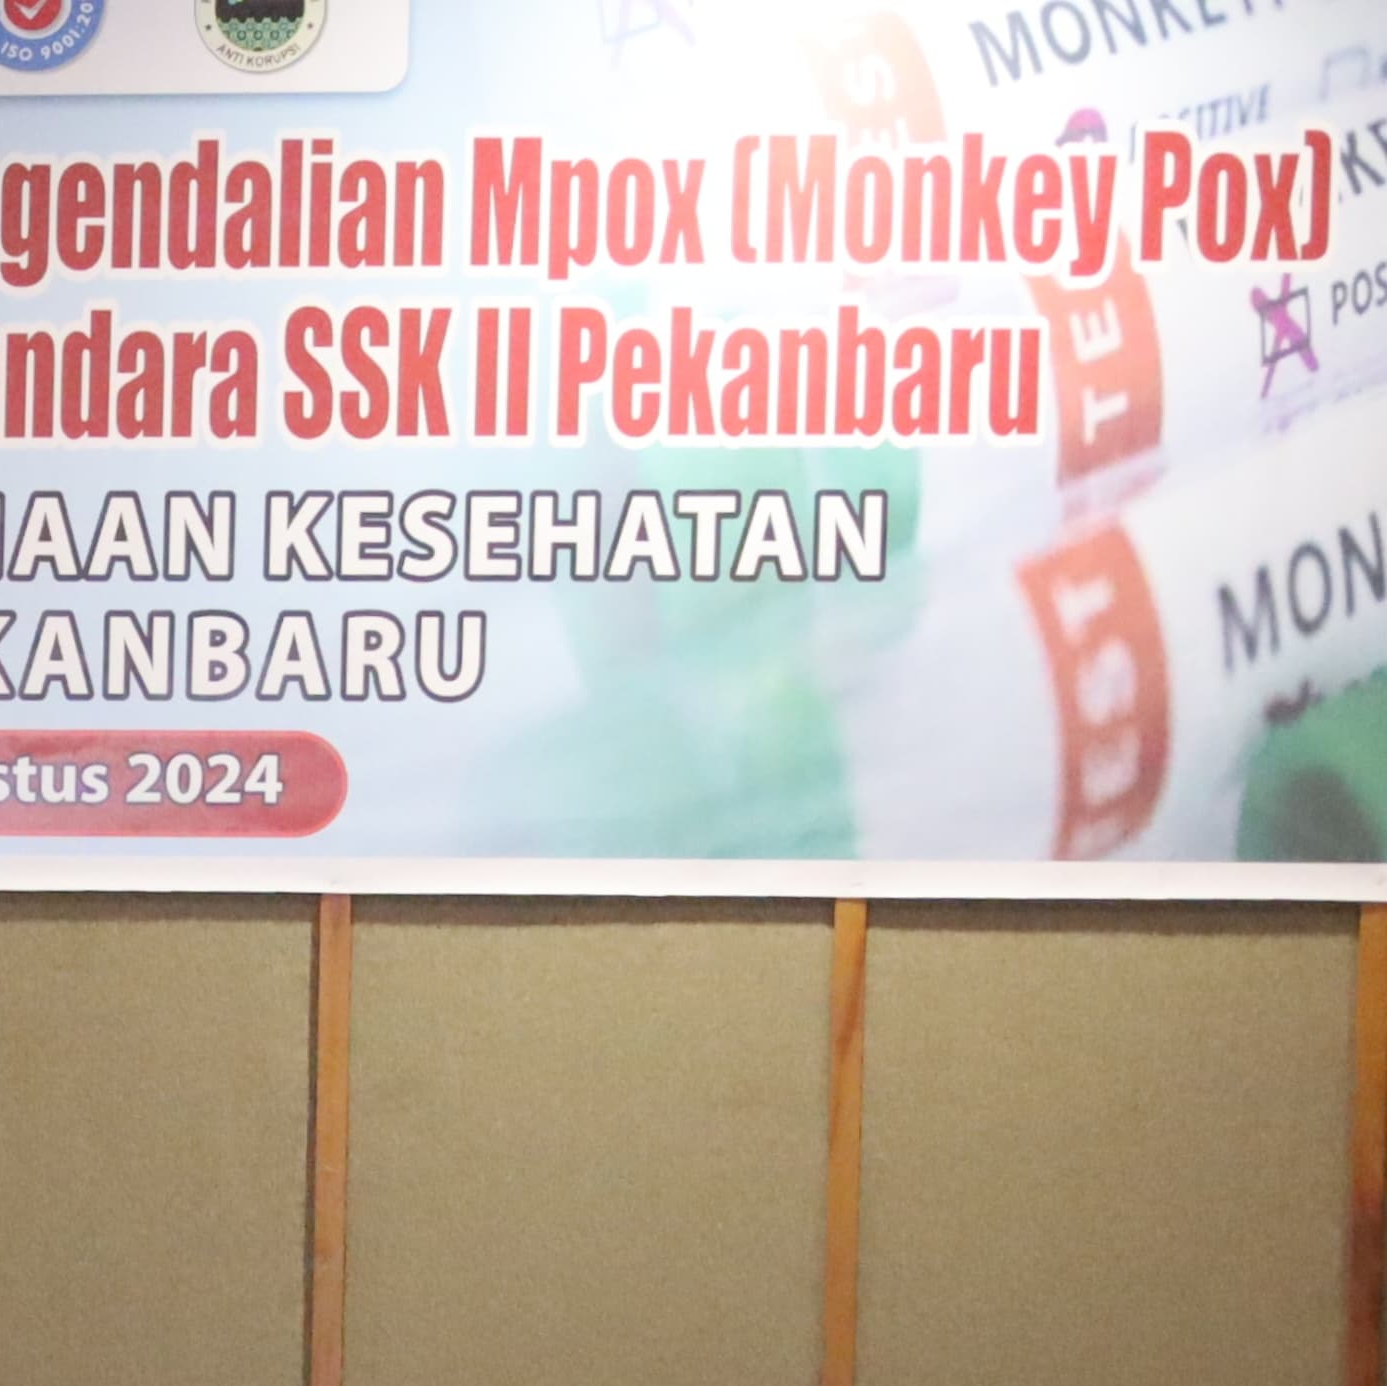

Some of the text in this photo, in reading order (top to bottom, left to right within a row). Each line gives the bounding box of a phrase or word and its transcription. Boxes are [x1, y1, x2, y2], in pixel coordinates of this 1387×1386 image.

[0, 42, 33, 62] ISO
[216, 44, 244, 65] ANTI
[470, 137, 704, 280] Mpox
[732, 132, 1117, 277] (Monkey
[1139, 129, 1333, 263] Pox)
[283, 307, 451, 440] SSK
[474, 307, 531, 437] II
[557, 305, 1041, 437] Pekanbaru
[264, 490, 887, 582] KESEHATAN
[125, 753, 283, 805] 2024
